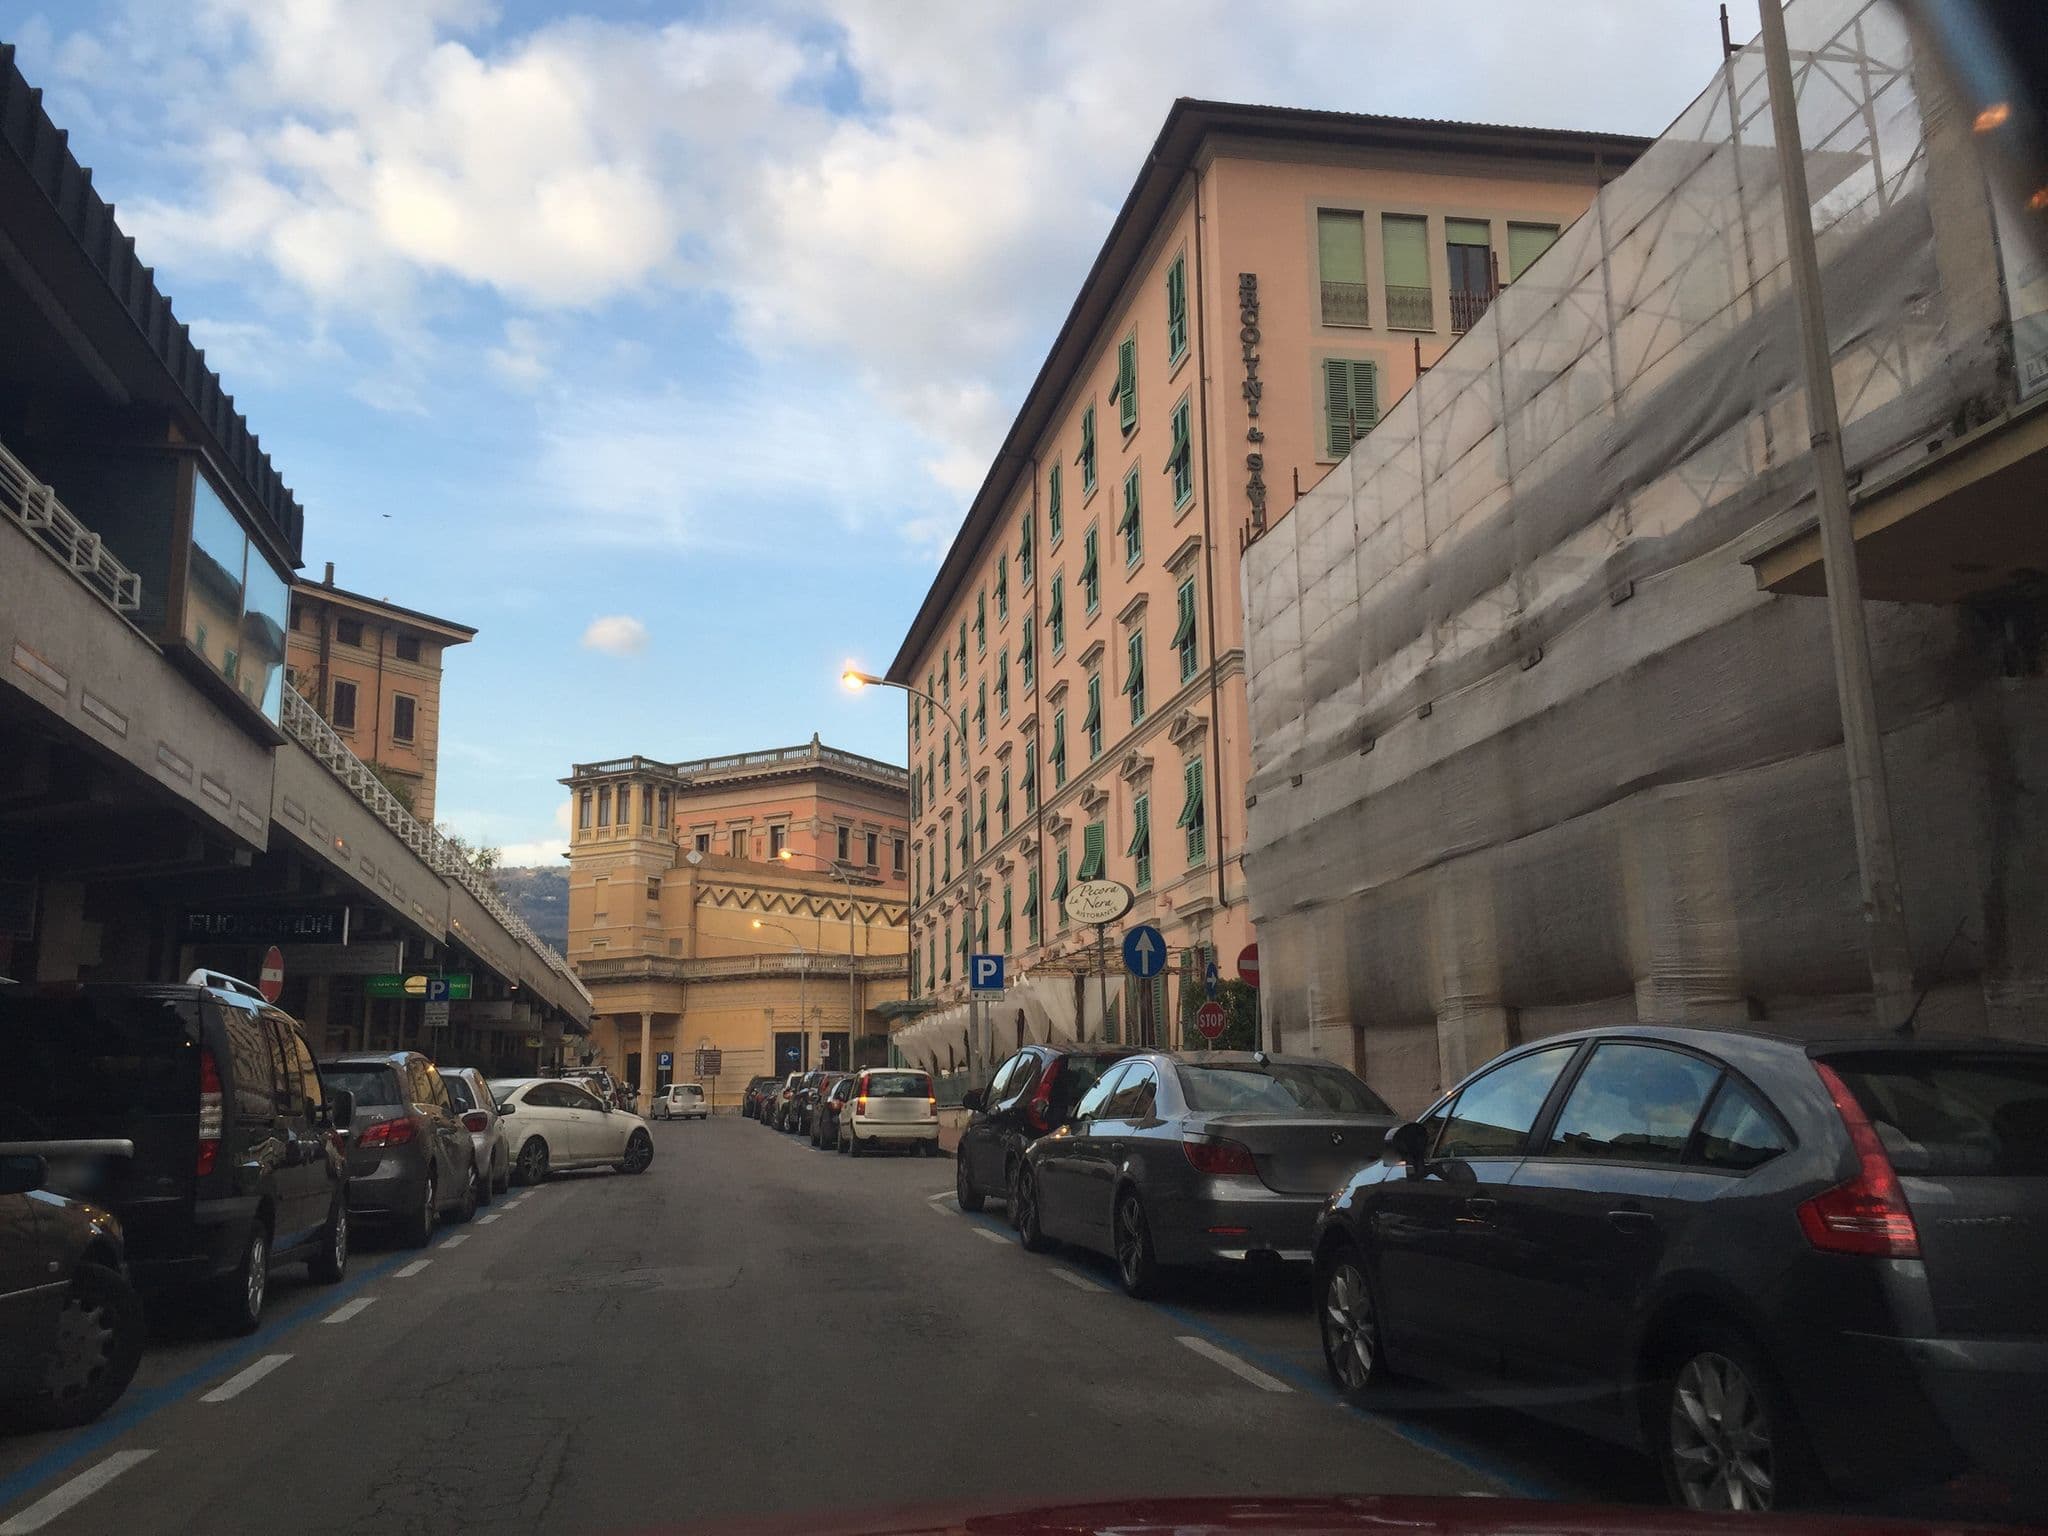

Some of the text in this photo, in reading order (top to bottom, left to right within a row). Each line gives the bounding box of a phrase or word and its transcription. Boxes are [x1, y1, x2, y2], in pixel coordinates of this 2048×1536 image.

[1080, 884, 1119, 897] Pecora
[1083, 895, 1113, 911] Nera
[1075, 906, 1118, 919] RISTORANTE
[977, 959, 996, 985] P
[430, 980, 446, 999] P
[1199, 1013, 1224, 1028] STOP
[661, 1055, 669, 1064] P
